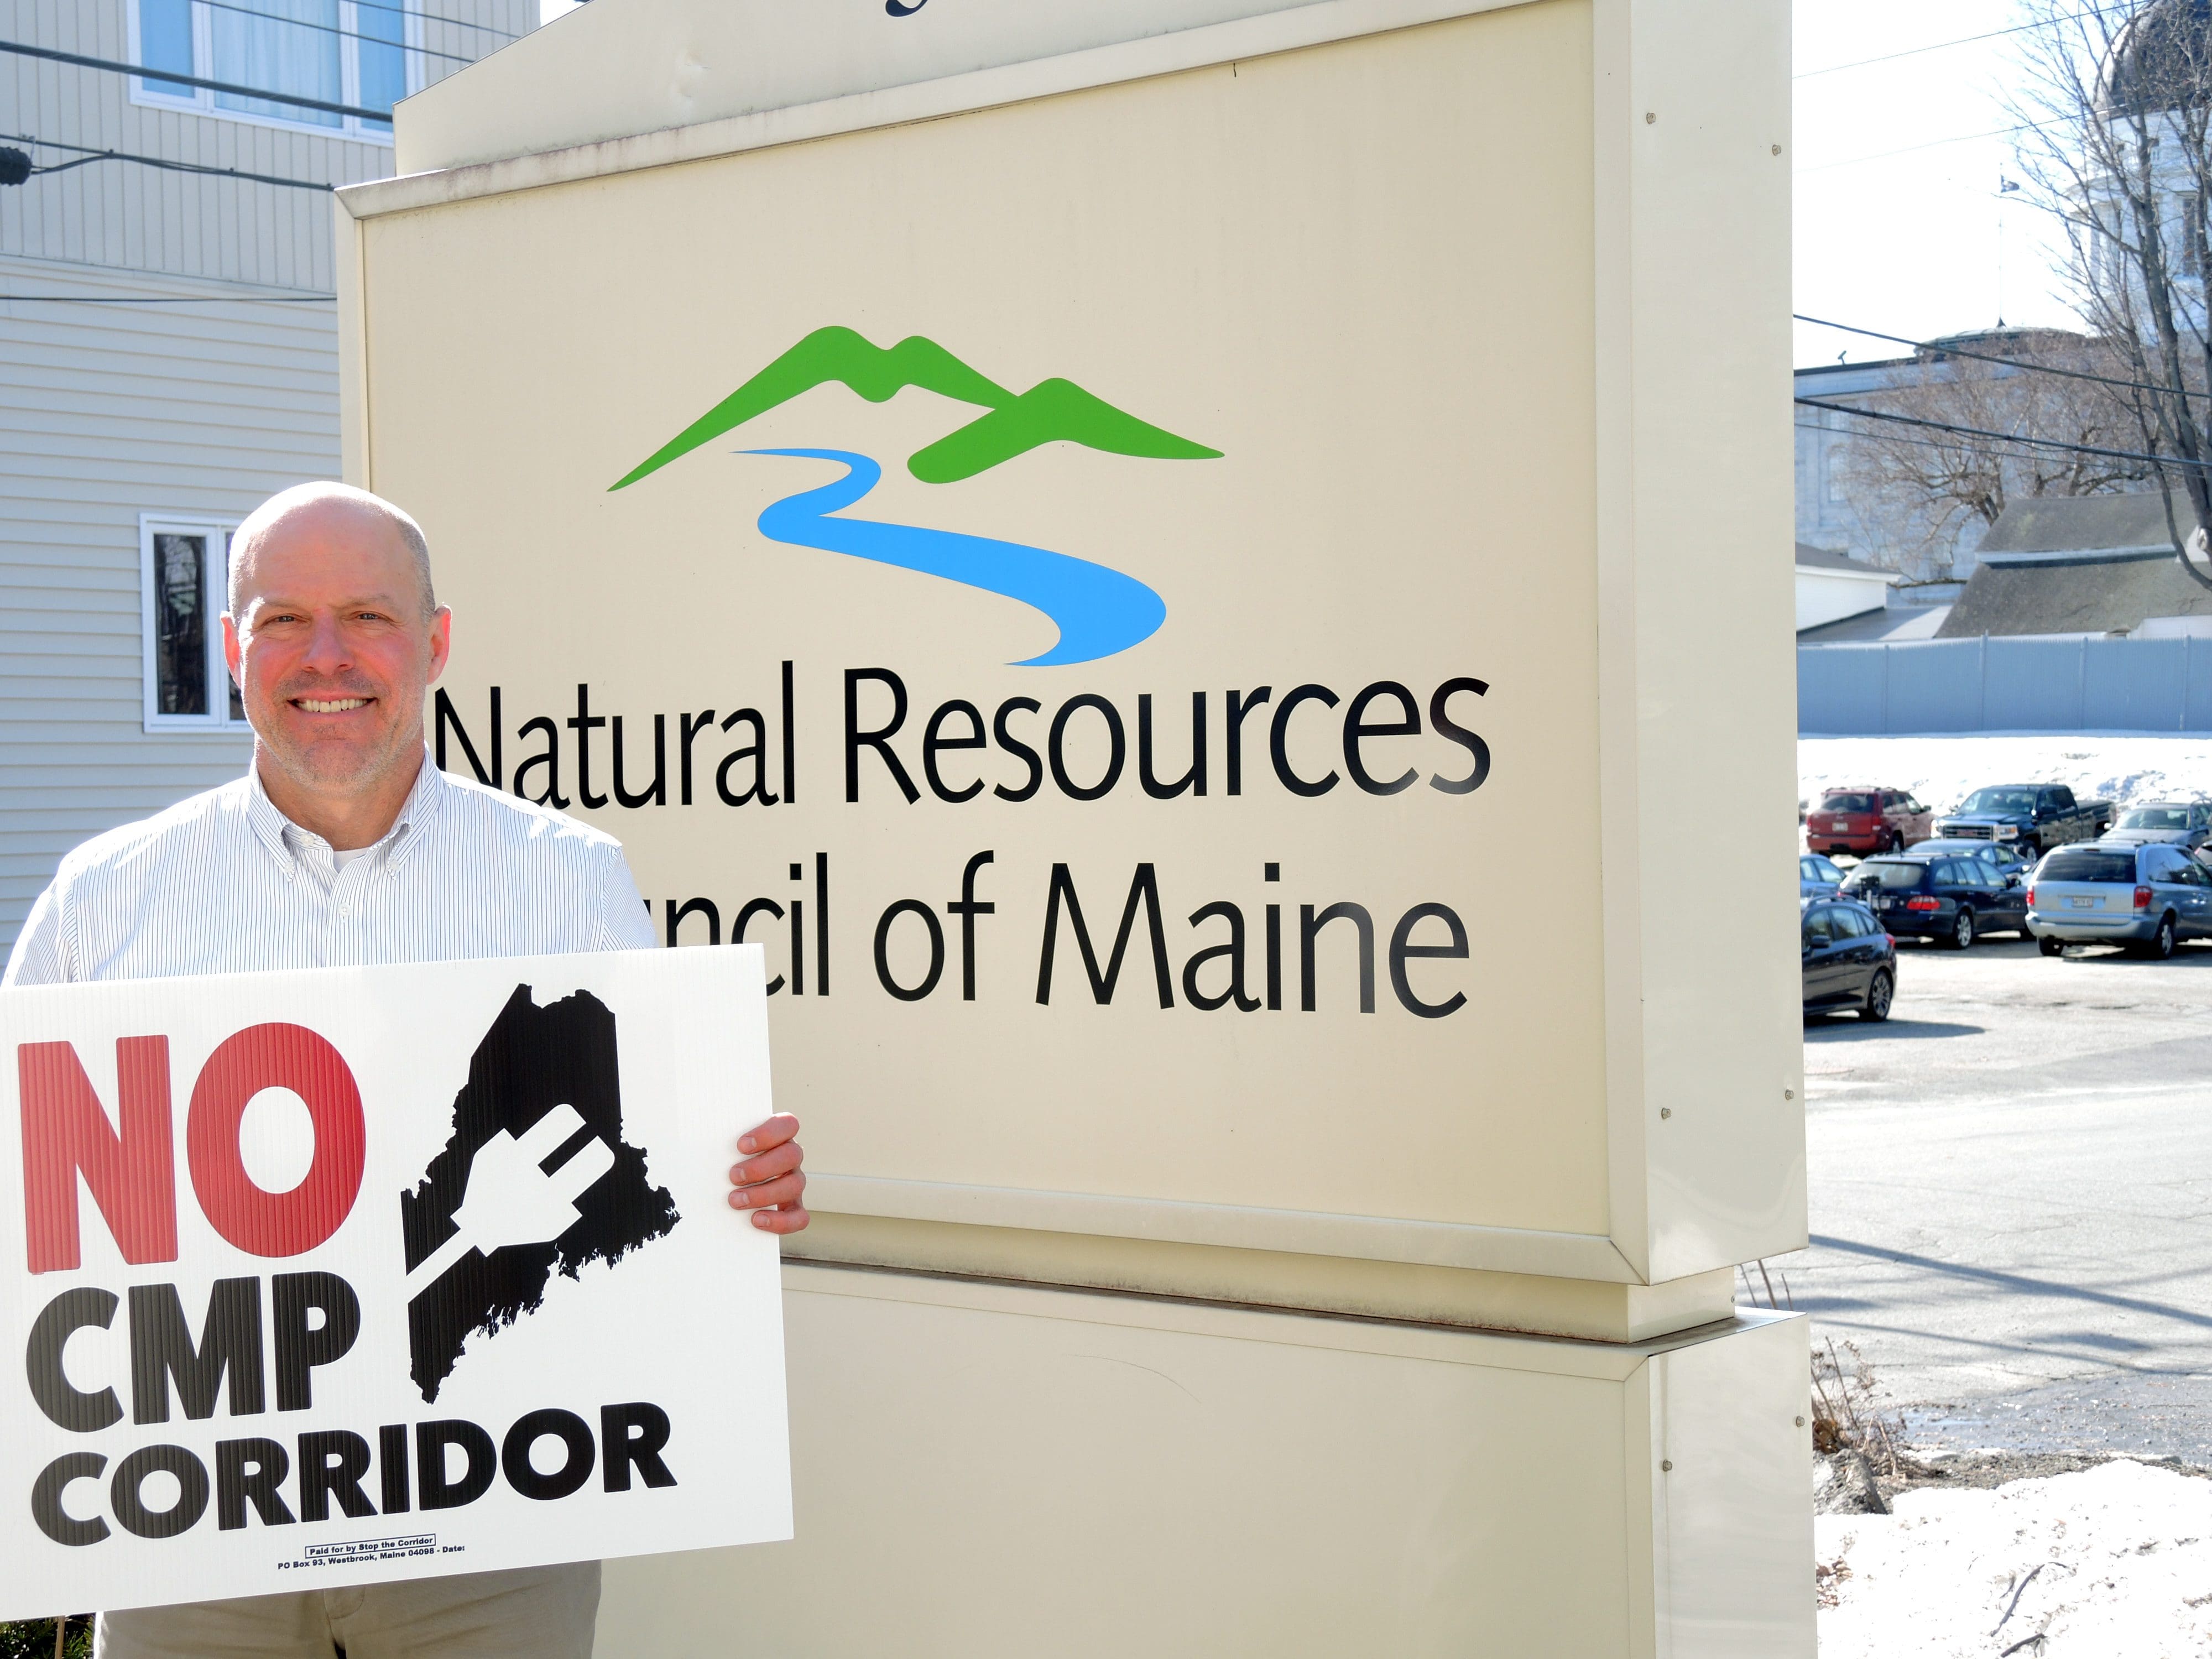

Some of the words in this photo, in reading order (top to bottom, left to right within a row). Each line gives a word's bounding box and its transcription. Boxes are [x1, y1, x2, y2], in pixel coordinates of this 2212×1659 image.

[435, 660, 795, 810] Natural
[844, 667, 1491, 805] Resources
[643, 852, 830, 997] ncil
[873, 850, 995, 1001] of
[1035, 862, 1469, 1019] Maine
[18, 1022, 366, 1274] NO
[26, 1271, 361, 1433] CMP
[31, 1402, 678, 1547] CORRIDOR
[310, 1547, 329, 1556] Paid
[346, 1545, 356, 1553] by
[398, 1537, 433, 1547] Corridor
[328, 1554, 377, 1565] Westbrook,
[380, 1551, 406, 1559] Maine
[408, 1548, 434, 1556] 04098
